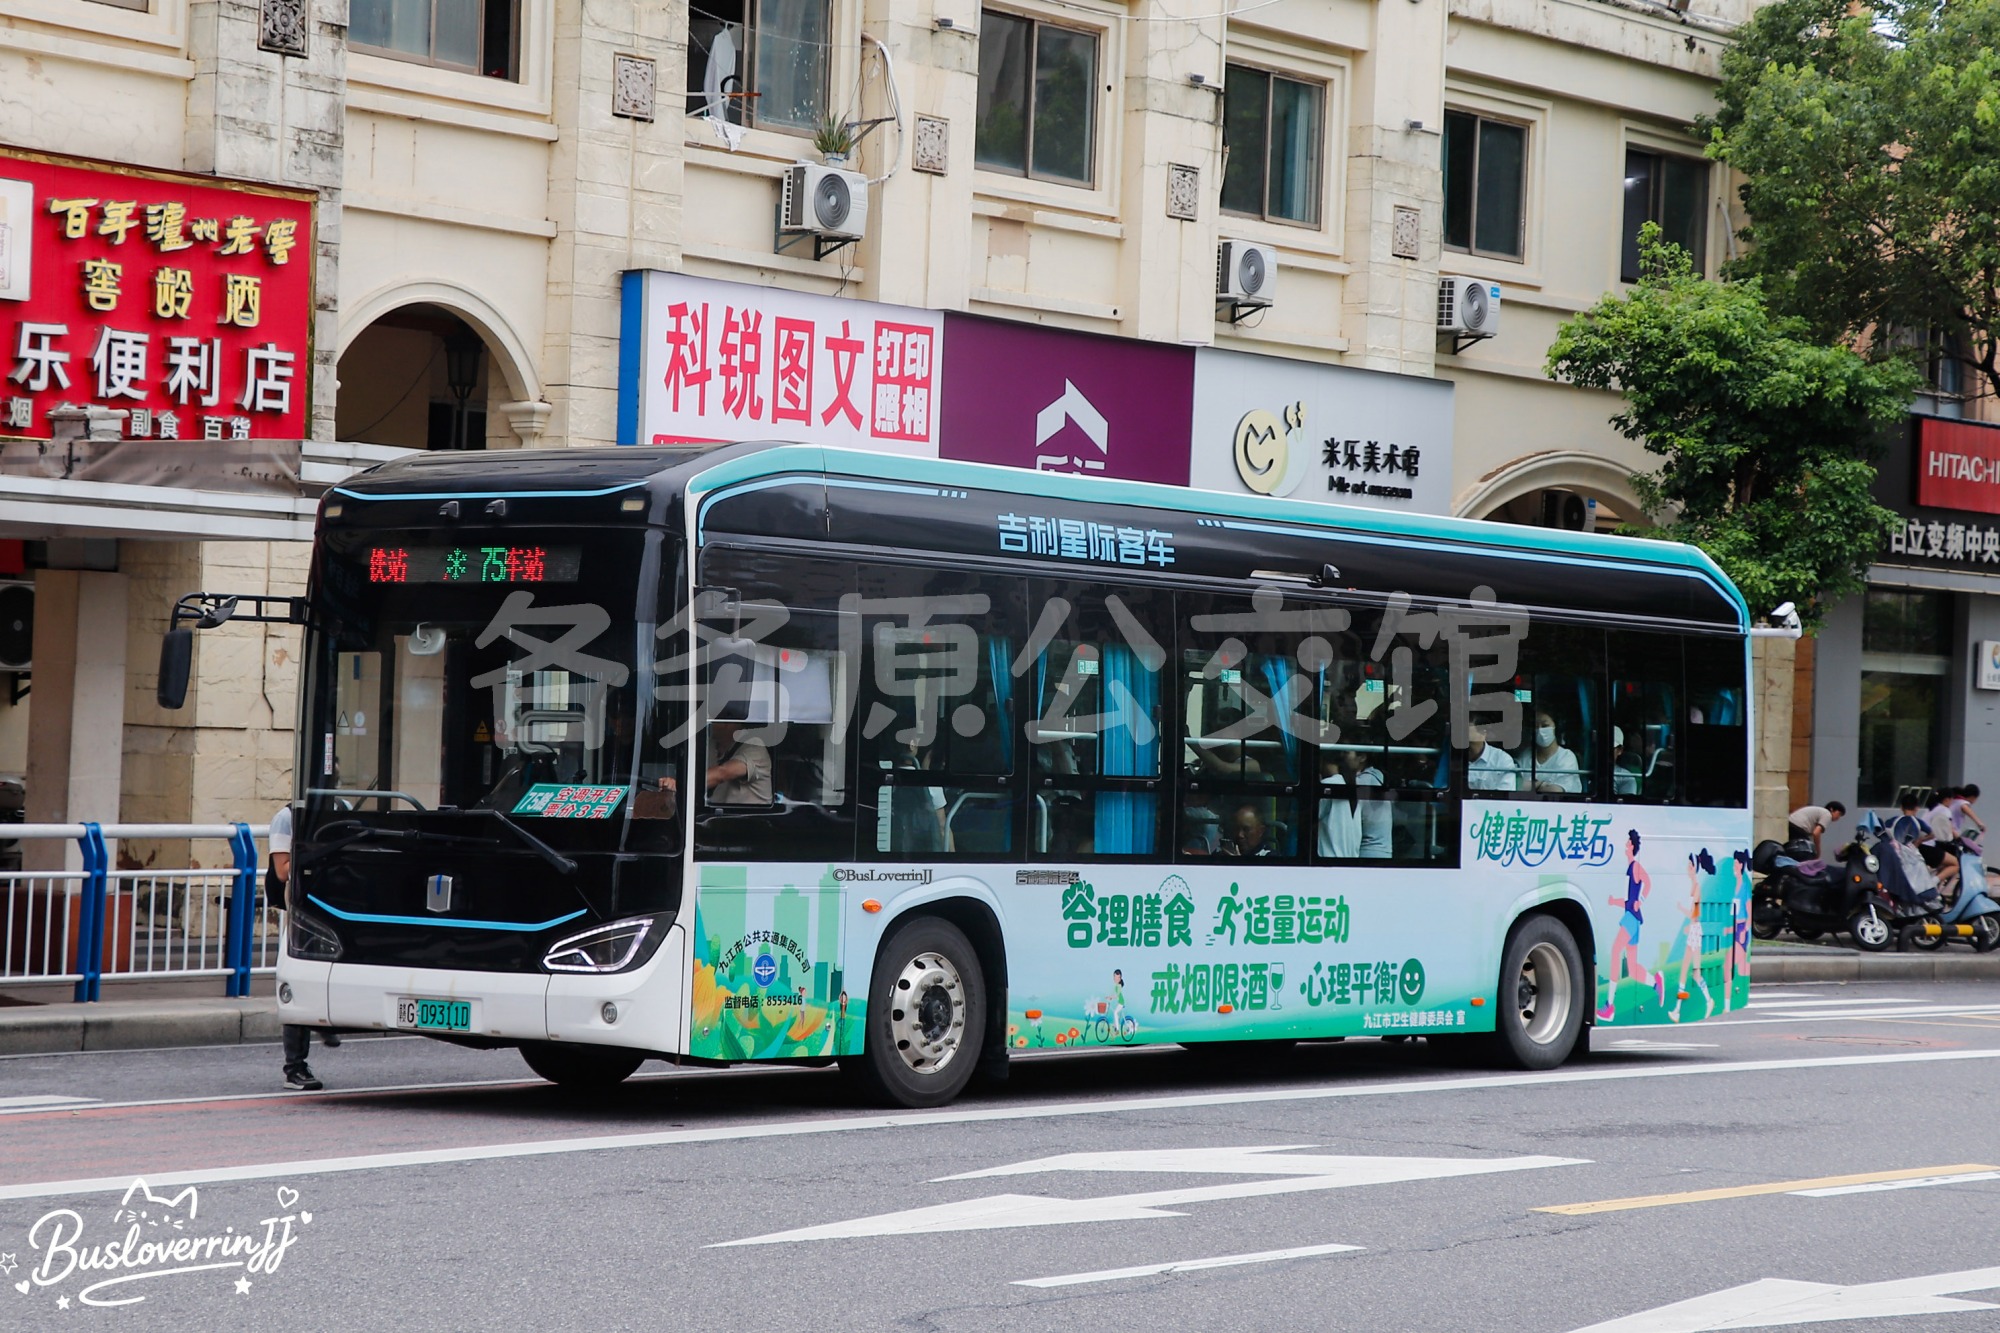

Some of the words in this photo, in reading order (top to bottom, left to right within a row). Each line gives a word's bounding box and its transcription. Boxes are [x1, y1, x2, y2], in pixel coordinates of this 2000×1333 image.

[84, 258, 261, 328] 窖龄酒
[8, 321, 296, 414] 乐便利店
[664, 301, 864, 432] 科锐图文
[877, 327, 930, 381] 打印
[9, 396, 33, 428] 烟
[129, 408, 181, 440] 副食
[203, 415, 251, 440] 百货
[874, 383, 928, 436] 照相
[1322, 437, 1420, 477] 米乐美术馆
[1928, 450, 2000, 484] HITACHI
[480, 547, 507, 582] 75
[997, 512, 1176, 567] 吉利星际客车
[1891, 518, 2000, 563] 日立变频中央
[552, 787, 623, 804] 空调开启
[1470, 808, 1614, 869] 健康四大基石
[1062, 889, 1195, 949] 合理膳食
[1243, 895, 1350, 946] 适量运动
[719, 930, 811, 974] 九江市公共交通集团公司
[1150, 962, 1269, 1014] 戒烟限酒
[1300, 961, 1399, 1007] 心理平衡
[1363, 1010, 1454, 1029] 九江市卫生健康委员会
